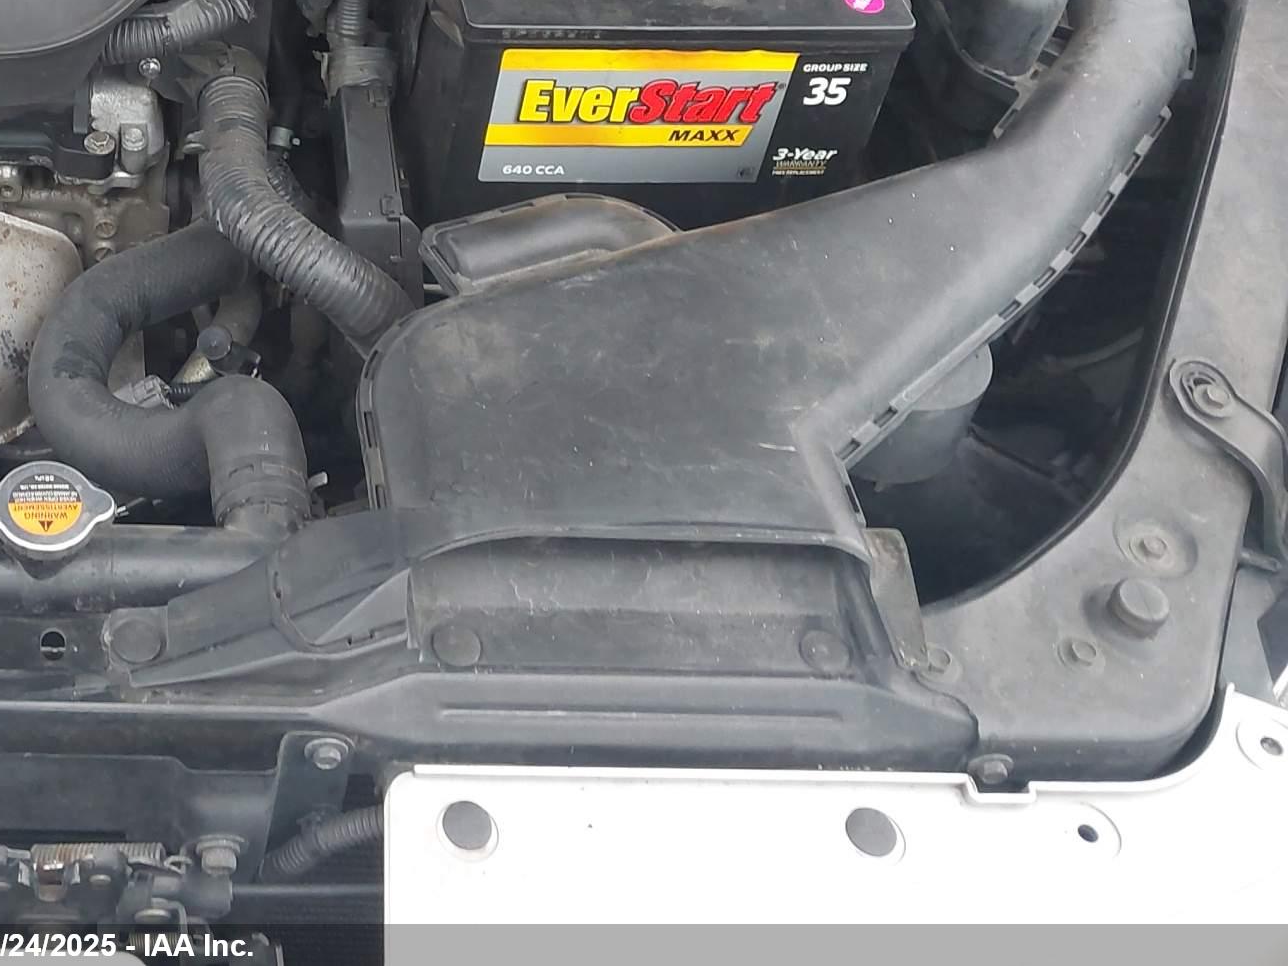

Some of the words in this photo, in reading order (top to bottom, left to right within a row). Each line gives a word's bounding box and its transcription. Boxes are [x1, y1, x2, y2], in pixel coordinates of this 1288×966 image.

[803, 63, 843, 72] GROUP
[843, 63, 868, 72] SIZE
[803, 77, 851, 105] 35
[518, 79, 776, 123] EverStart
[669, 129, 740, 141] MAXX
[772, 147, 838, 161] 3-Year
[502, 165, 533, 175] 640
[535, 165, 565, 175] CCA
